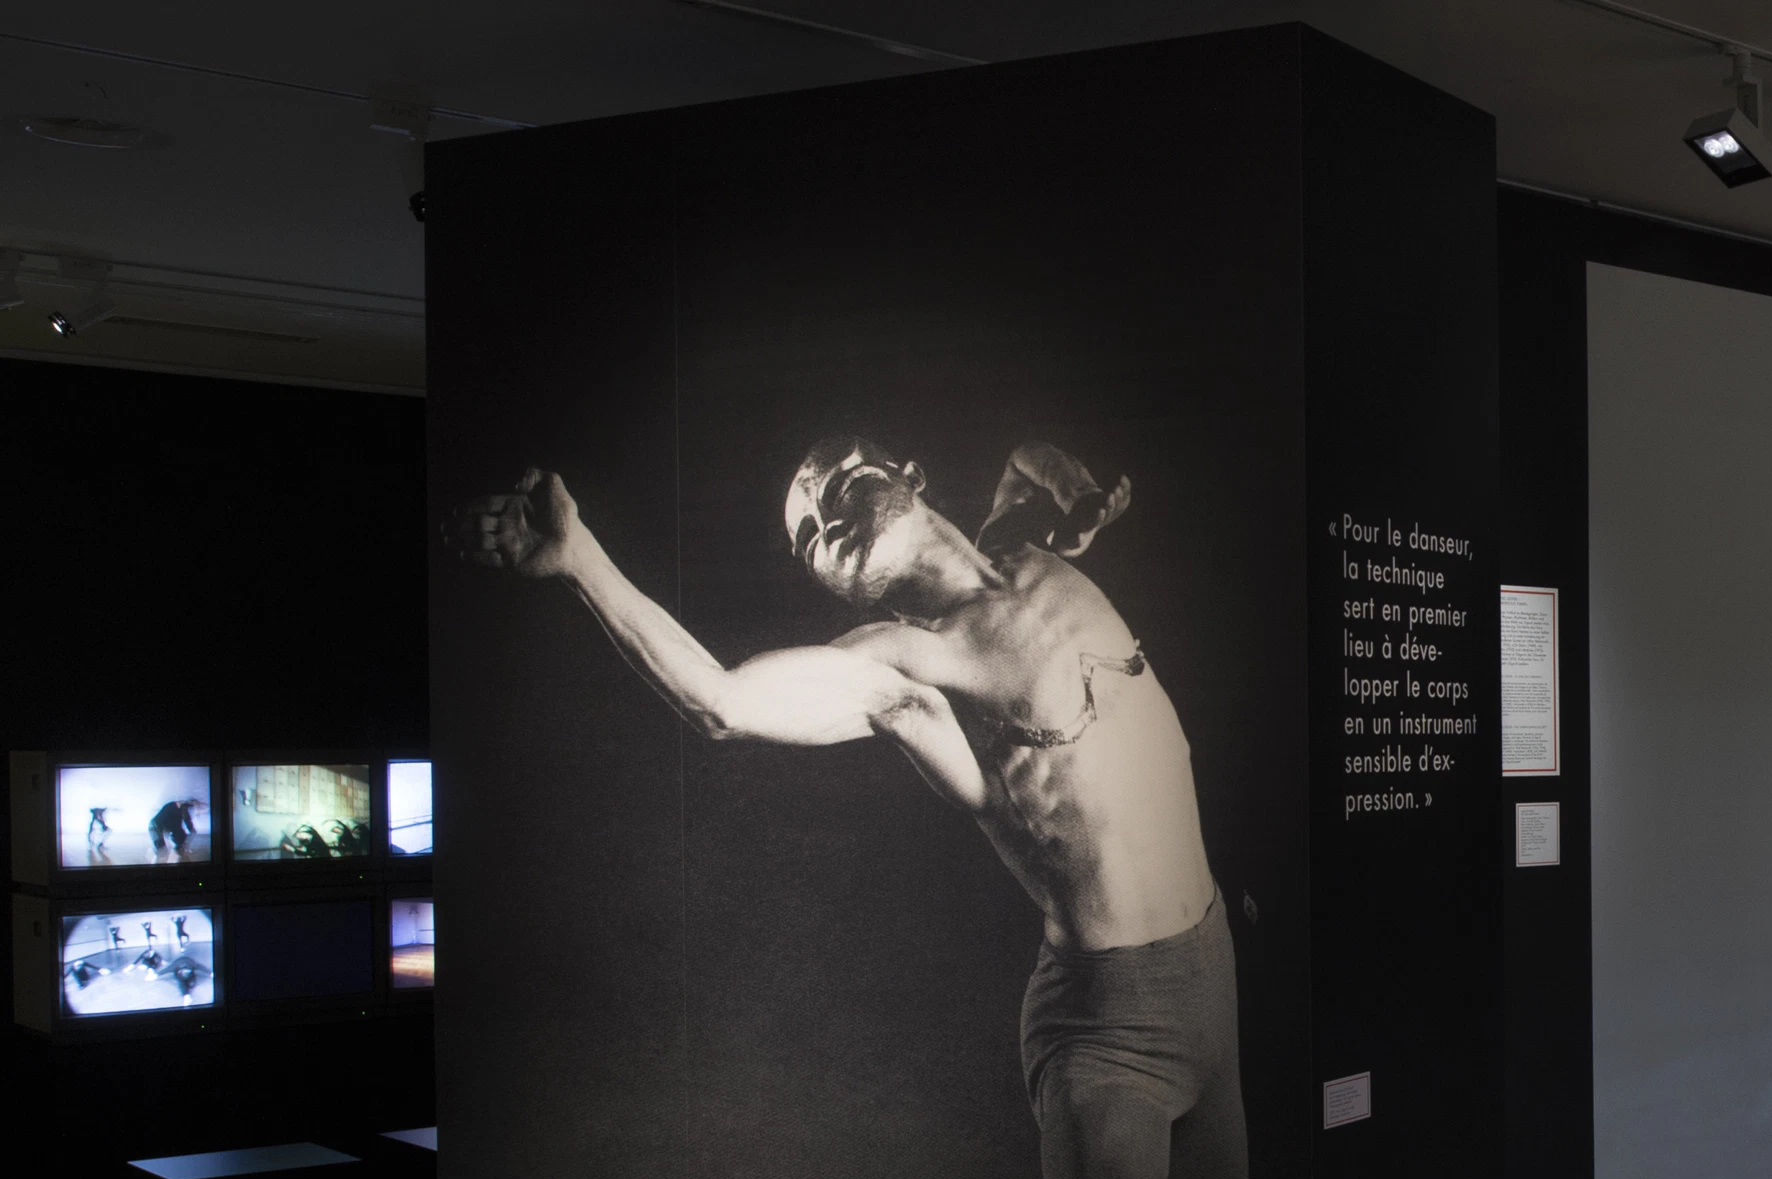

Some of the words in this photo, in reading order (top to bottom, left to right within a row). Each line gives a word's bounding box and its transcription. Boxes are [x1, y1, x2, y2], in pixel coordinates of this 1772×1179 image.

[1344, 514, 1379, 543] Pour
[1388, 519, 1401, 546] le
[1410, 523, 1472, 560] danseur,
[1344, 551, 1358, 579] la
[1367, 557, 1444, 594] technique
[1344, 598, 1374, 619] sert
[1382, 604, 1400, 621] en
[1410, 604, 1466, 630] premier
[1345, 629, 1373, 657] lieu
[1382, 634, 1391, 658] à
[1400, 633, 1442, 661] déve-
[1345, 668, 1399, 704] lopper
[1407, 670, 1420, 697] le
[1428, 682, 1468, 705] corps
[1345, 718, 1363, 734] en
[1373, 718, 1391, 734] un
[1400, 711, 1476, 734] instrument
[1346, 745, 1411, 773] sensible
[1346, 787, 1418, 820] pression.
